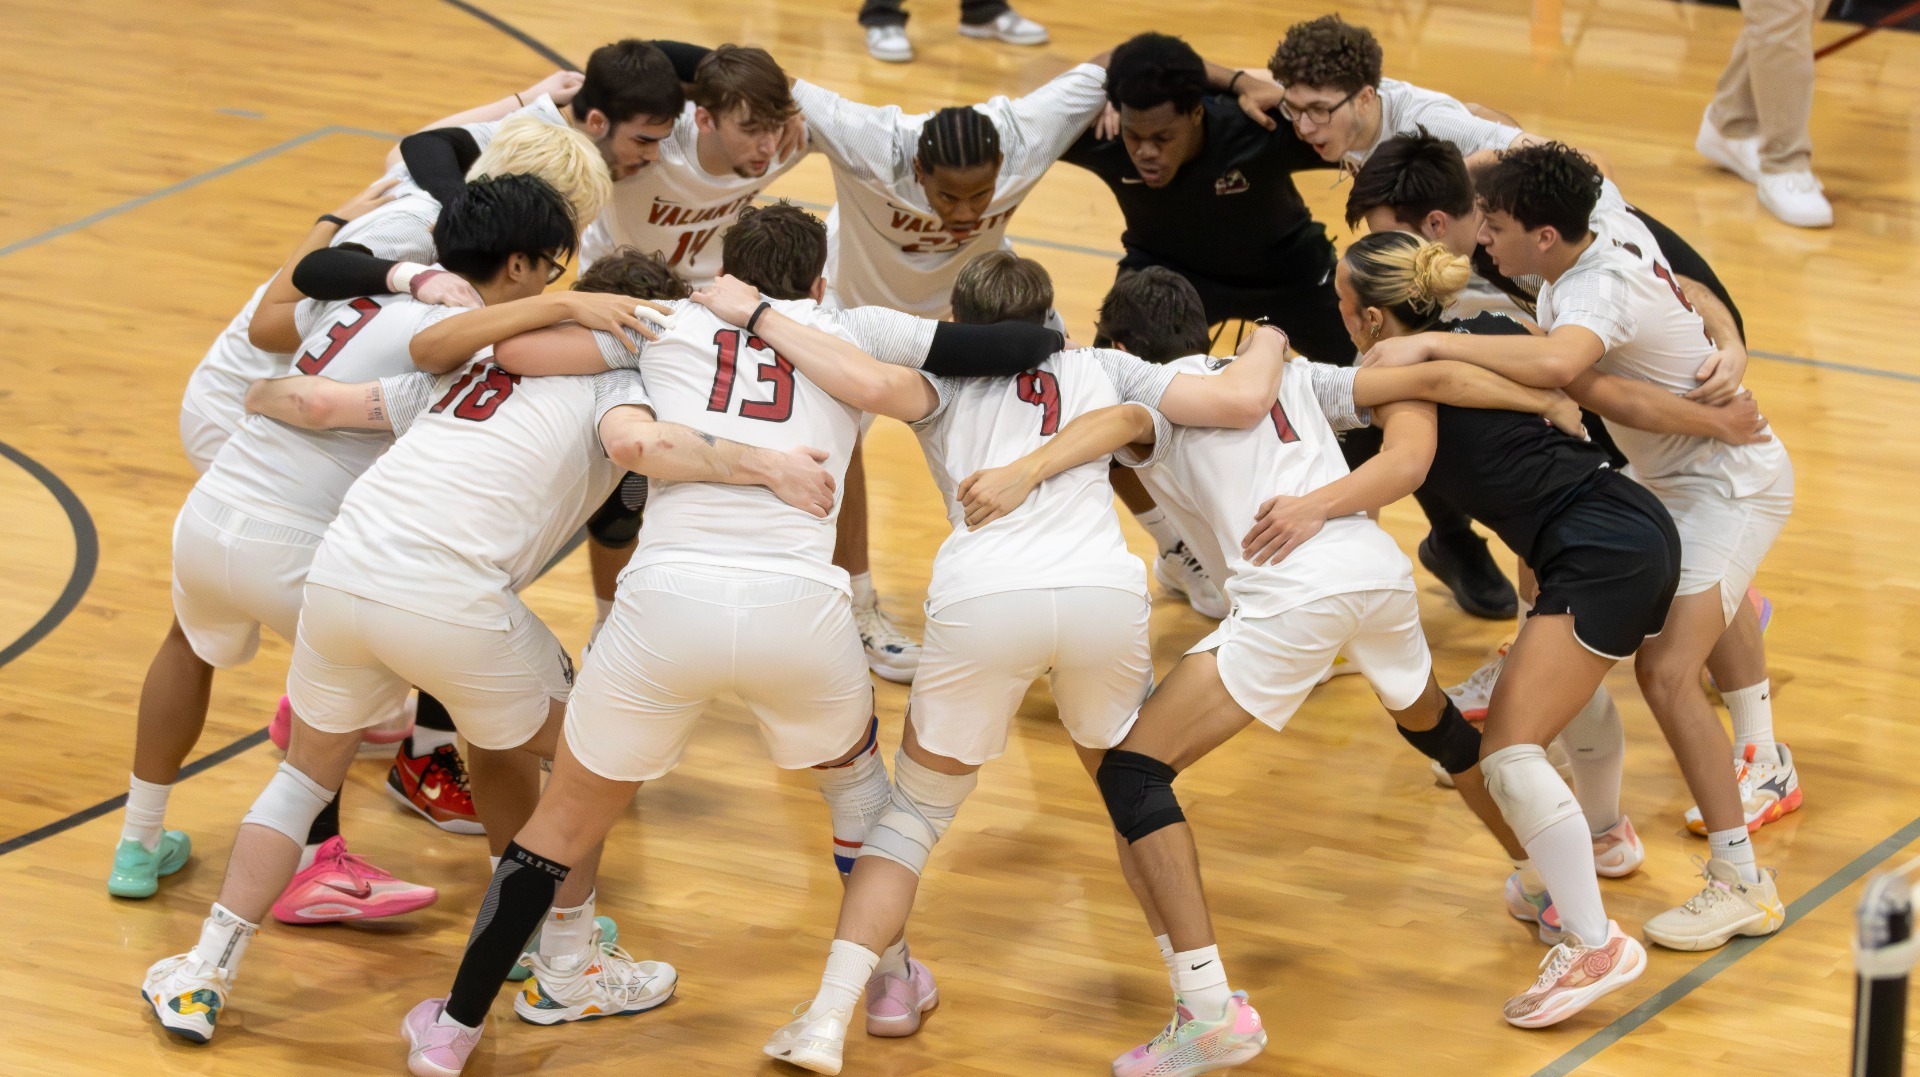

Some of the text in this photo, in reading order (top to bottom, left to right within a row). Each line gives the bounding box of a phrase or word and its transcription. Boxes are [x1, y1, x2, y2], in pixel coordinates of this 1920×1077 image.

[667, 225, 720, 268] 14
[295, 296, 382, 375] 3
[706, 328, 795, 423] 13
[1016, 369, 1061, 436] 9
